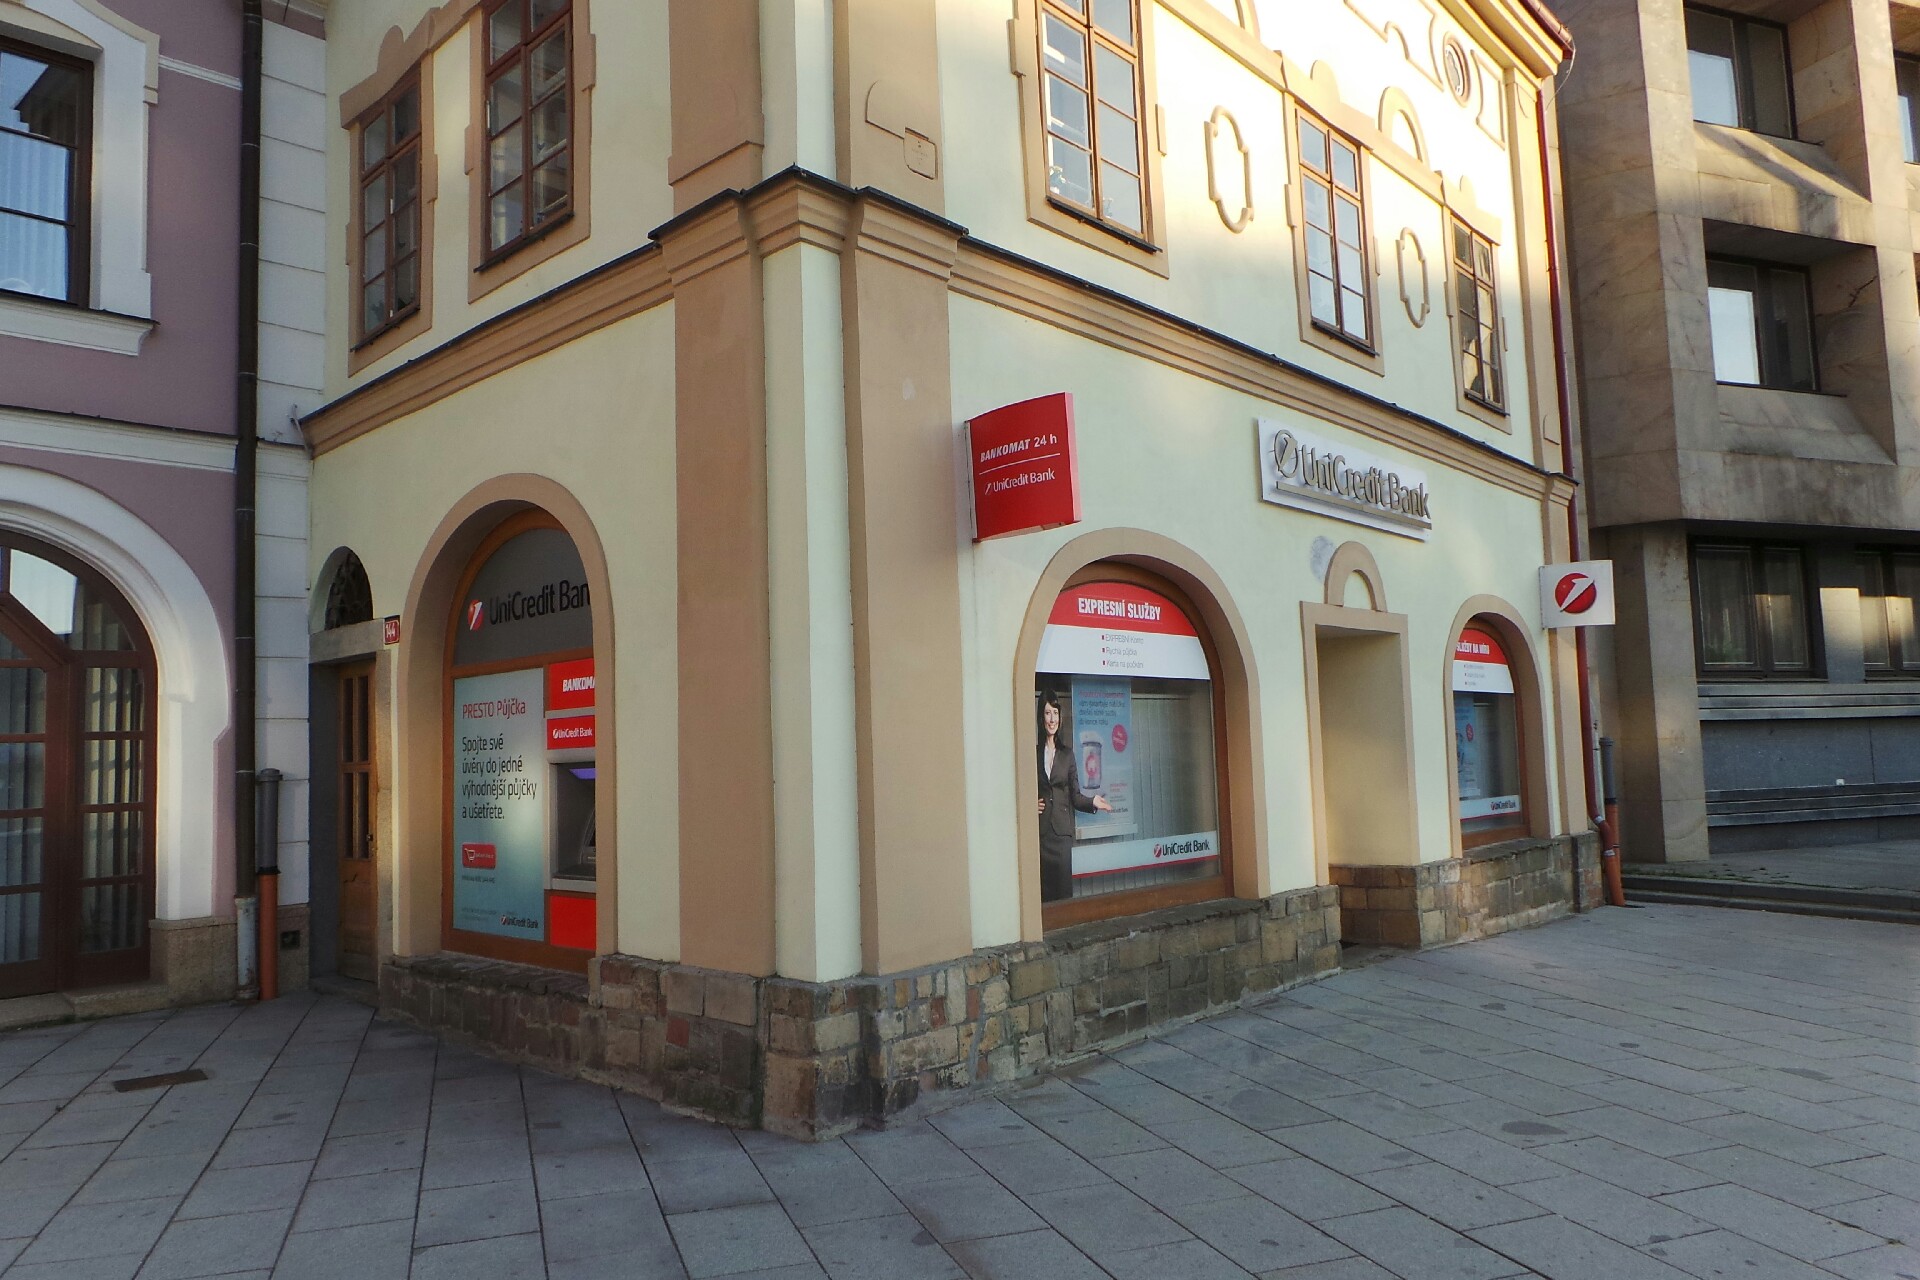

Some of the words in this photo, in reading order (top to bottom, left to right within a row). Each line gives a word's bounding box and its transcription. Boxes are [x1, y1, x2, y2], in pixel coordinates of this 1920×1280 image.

[980, 439, 1031, 463] BANKOMAT
[1033, 434, 1047, 448] 24
[1049, 433, 1057, 445] h
[993, 474, 1029, 492] UniCredit
[1030, 467, 1056, 484] Bank
[1301, 444, 1387, 508] UniCredit
[1388, 472, 1431, 519] Bank
[489, 582, 556, 625] UniCredit
[559, 579, 591, 612] Ban
[1078, 597, 1126, 618] EXPRESNÍ
[1127, 602, 1161, 621] SLUŽBY
[385, 622, 396, 639] 144
[562, 676, 596, 693] BANKOMA
[462, 701, 494, 719] PRESTO
[496, 698, 526, 719] Půjčka
[558, 728, 579, 738] UniCredit
[579, 727, 593, 737] Bank
[462, 736, 488, 756] Spojte
[489, 733, 504, 751] své
[462, 757, 485, 777] úvěry
[486, 758, 496, 773] do
[497, 755, 523, 776] jedné
[462, 779, 506, 800] výhodnější
[507, 778, 537, 800] půjčky
[462, 805, 467, 819] a
[468, 802, 505, 820] ušetřete.
[1162, 841, 1192, 857] UniCredit
[1193, 839, 1210, 852] Bank
[527, 918, 539, 929] Bank
